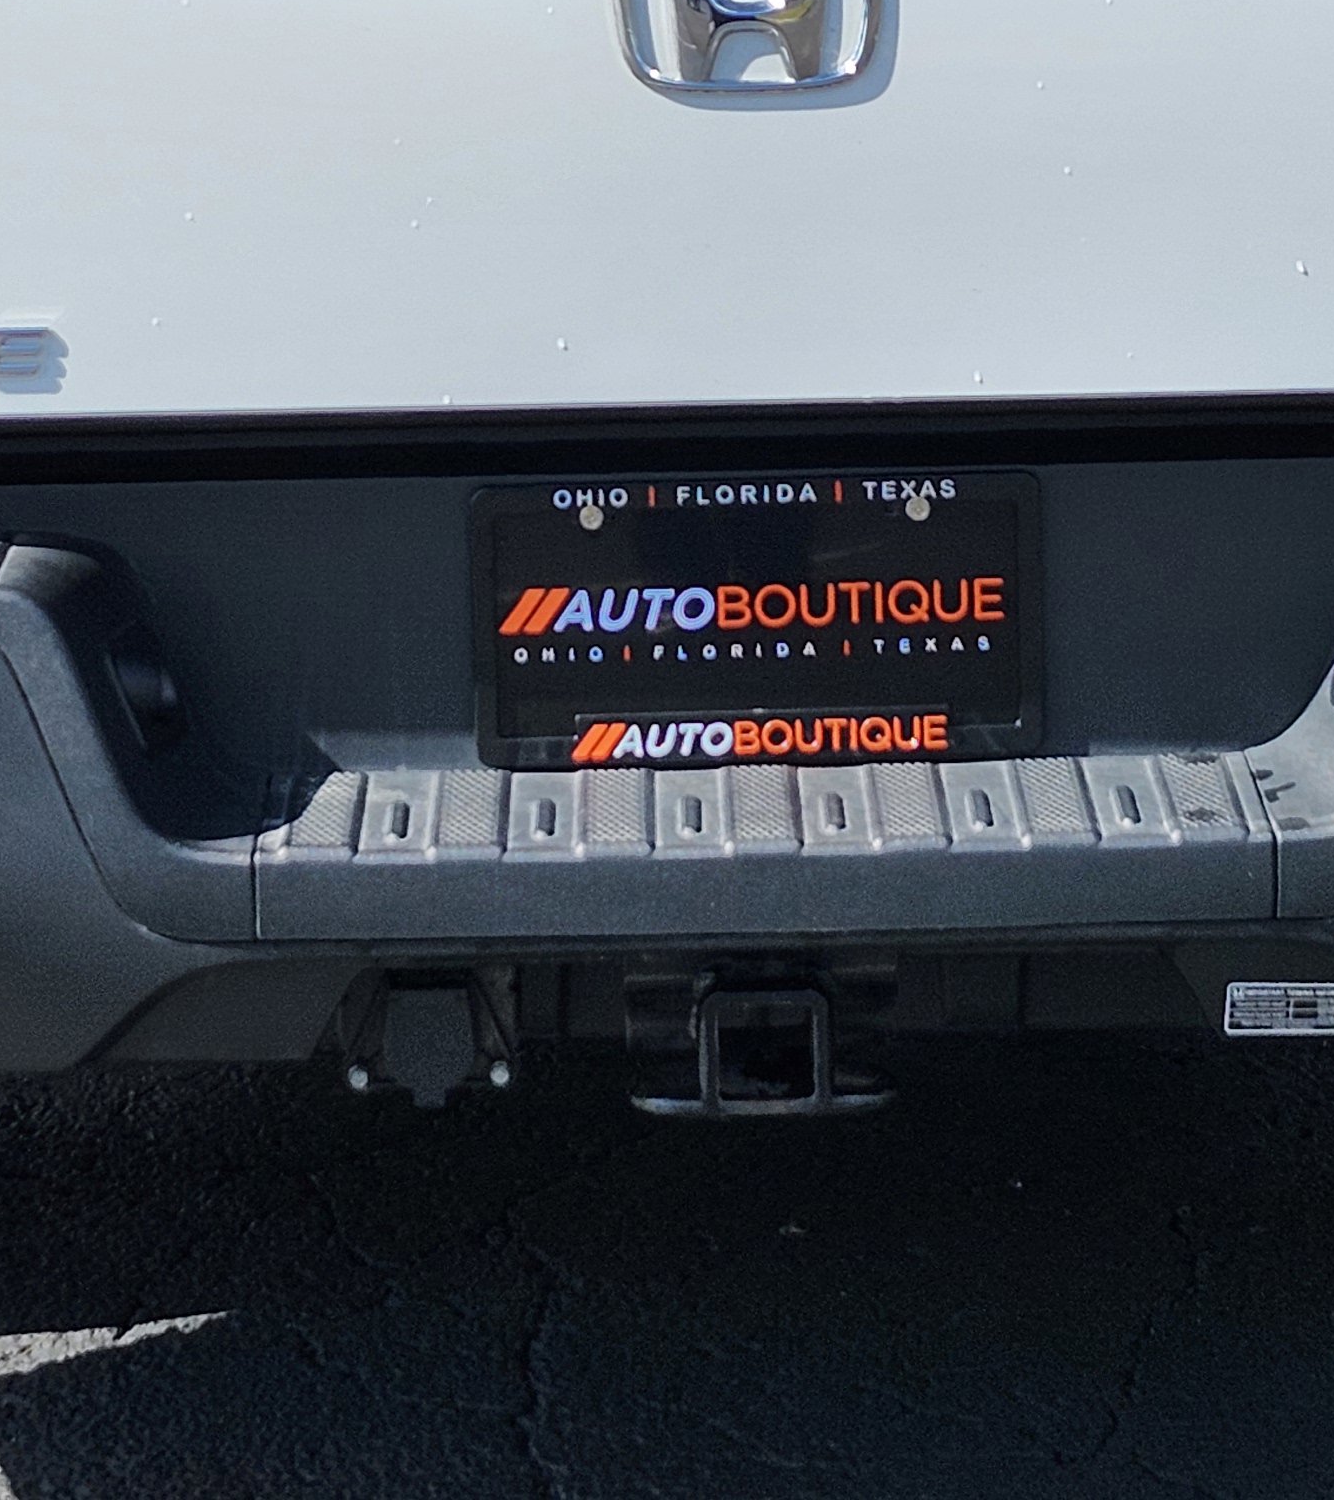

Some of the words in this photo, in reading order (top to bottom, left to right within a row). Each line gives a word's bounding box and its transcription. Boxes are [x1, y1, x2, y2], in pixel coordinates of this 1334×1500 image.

[553, 486, 629, 510] OHIO
[675, 482, 818, 506] FLORIDA
[862, 478, 957, 502] TEXAS
[552, 577, 1005, 633] AUTOBOUTIQUE
[513, 646, 604, 665] OHIO
[653, 641, 817, 661] FLORIDA
[874, 635, 991, 655] TEXAS
[614, 714, 949, 759] AUTOBOUTIQUE
